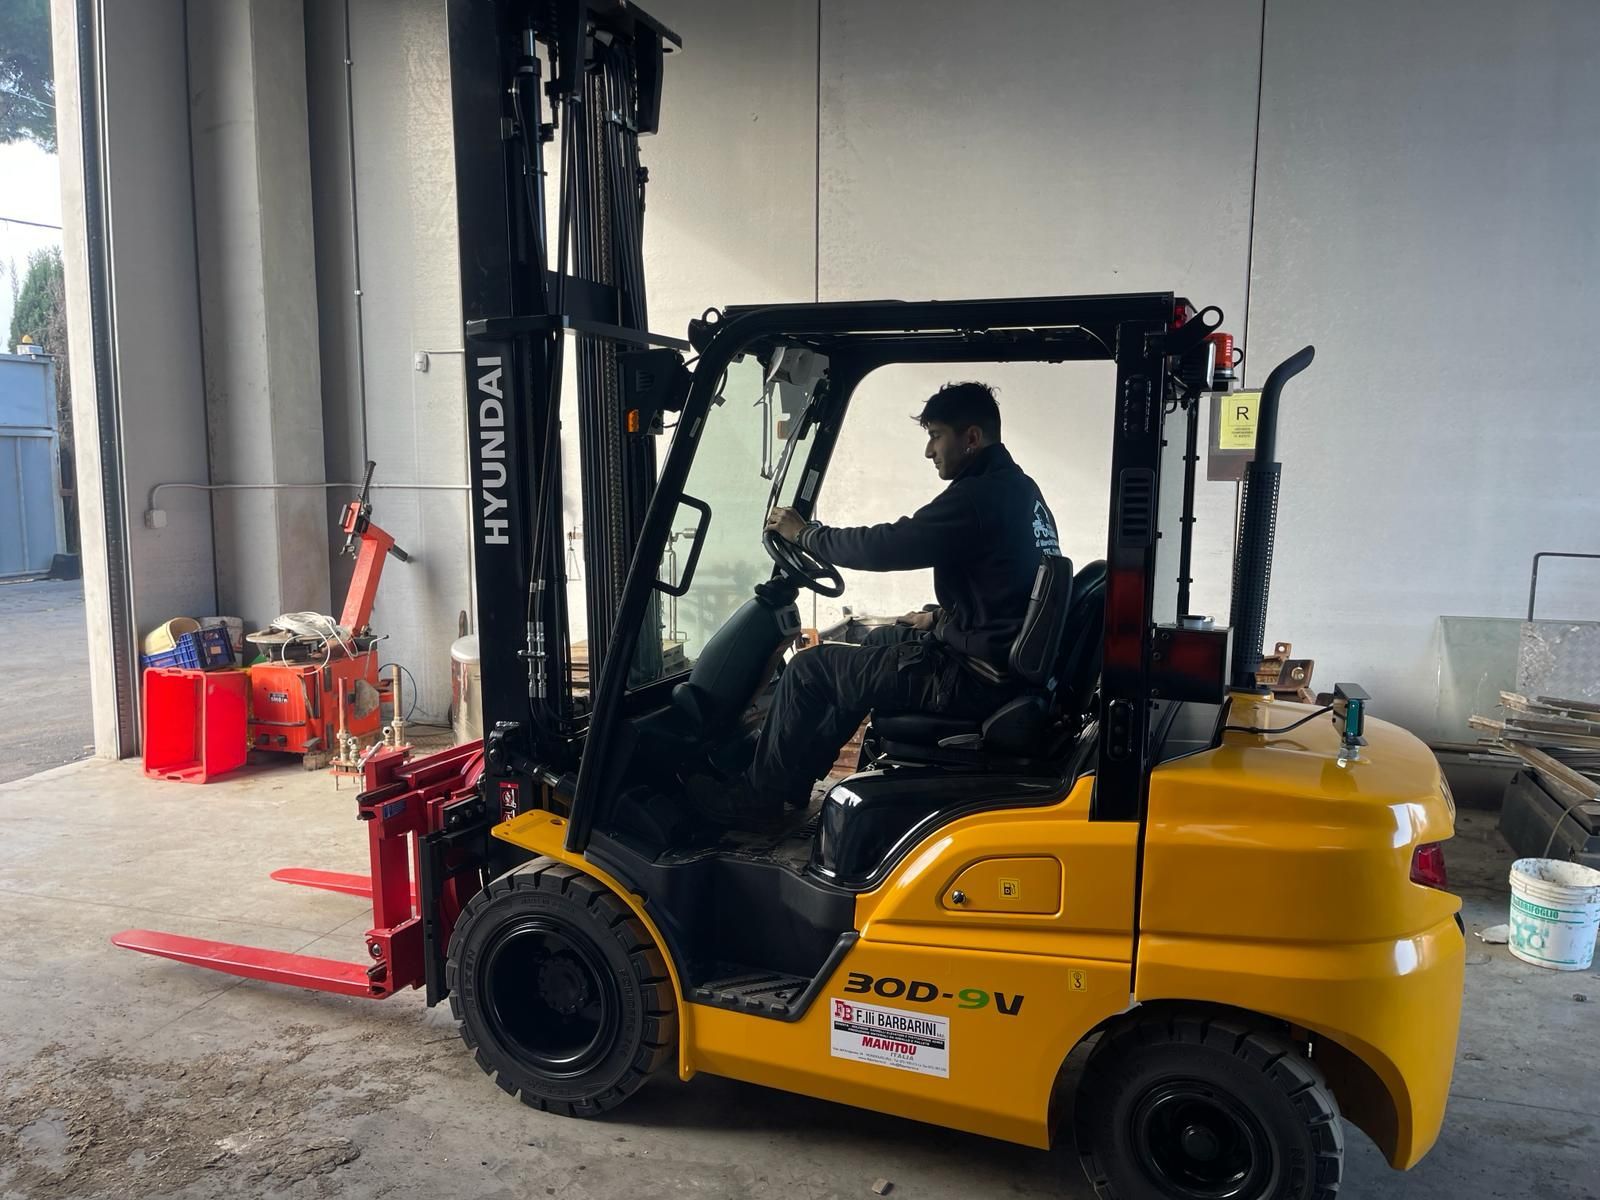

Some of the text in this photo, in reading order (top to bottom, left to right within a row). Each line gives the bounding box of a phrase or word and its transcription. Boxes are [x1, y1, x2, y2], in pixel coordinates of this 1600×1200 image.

[1237, 406, 1249, 420] R
[477, 356, 509, 545] HYUNDAI
[877, 1013, 938, 1037] BARBARINI
[862, 1036, 917, 1056] MANITOU
